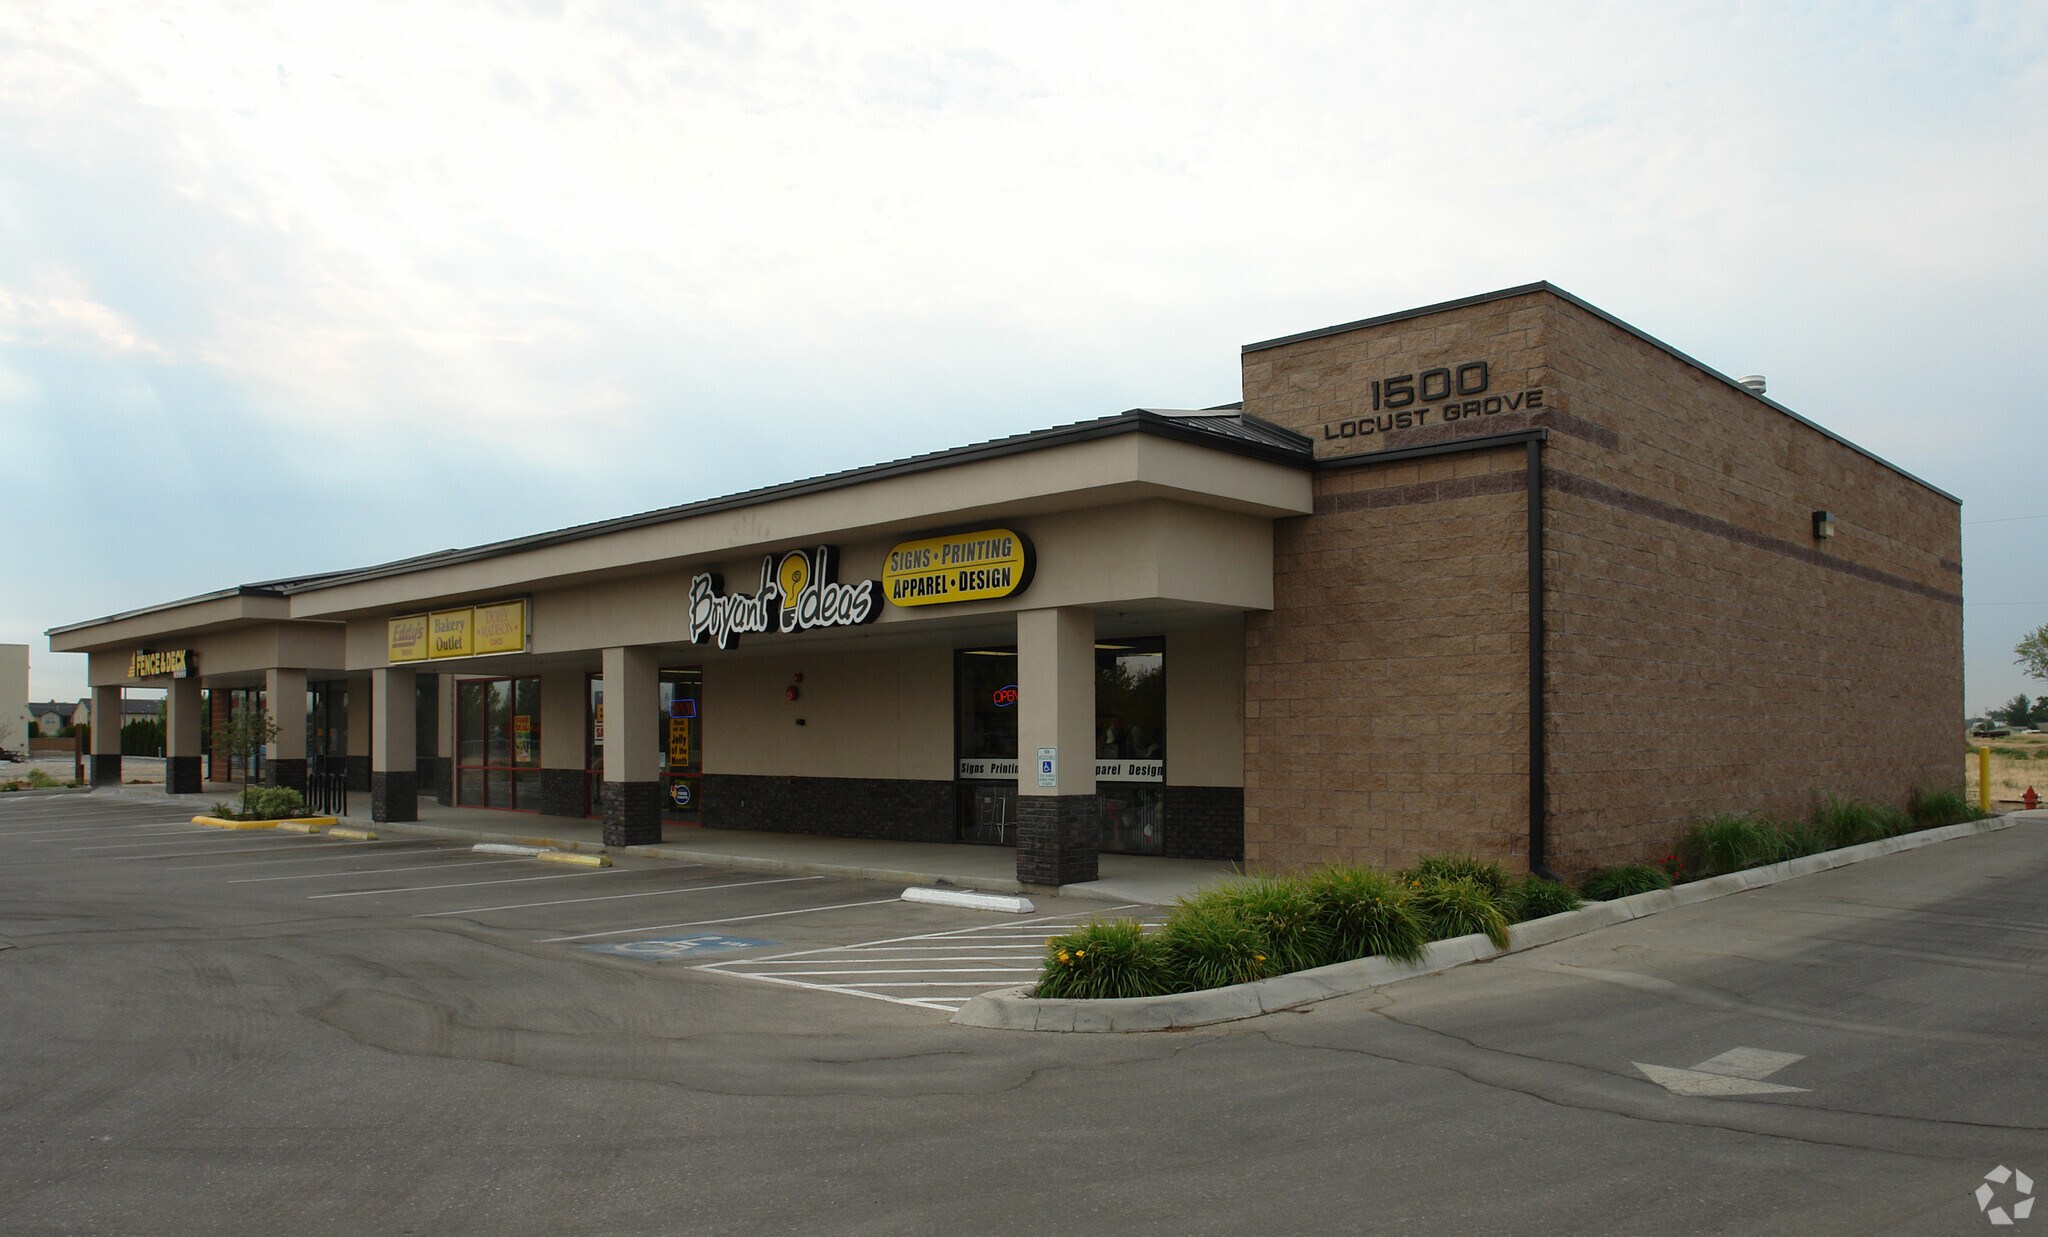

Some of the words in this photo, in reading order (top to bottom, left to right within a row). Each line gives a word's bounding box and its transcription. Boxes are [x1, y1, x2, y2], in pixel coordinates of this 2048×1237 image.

[1371, 361, 1487, 410] 1500
[1324, 408, 1430, 439] LOCUST
[1443, 389, 1544, 421] GROVE
[890, 547, 930, 572] SIGNS
[941, 535, 1012, 565] PRINTING
[892, 573, 948, 599] APPAREL
[958, 566, 1011, 592] DESIGN
[688, 553, 777, 650] Bryant
[392, 622, 424, 648] Eddy's
[434, 618, 465, 634] Bakery
[436, 637, 463, 652] Outlet
[672, 734, 686, 746] Jelly
[961, 763, 985, 775] Signs
[991, 763, 1018, 774] Printin
[1096, 764, 1121, 775] parel
[1129, 764, 1163, 777] Design
